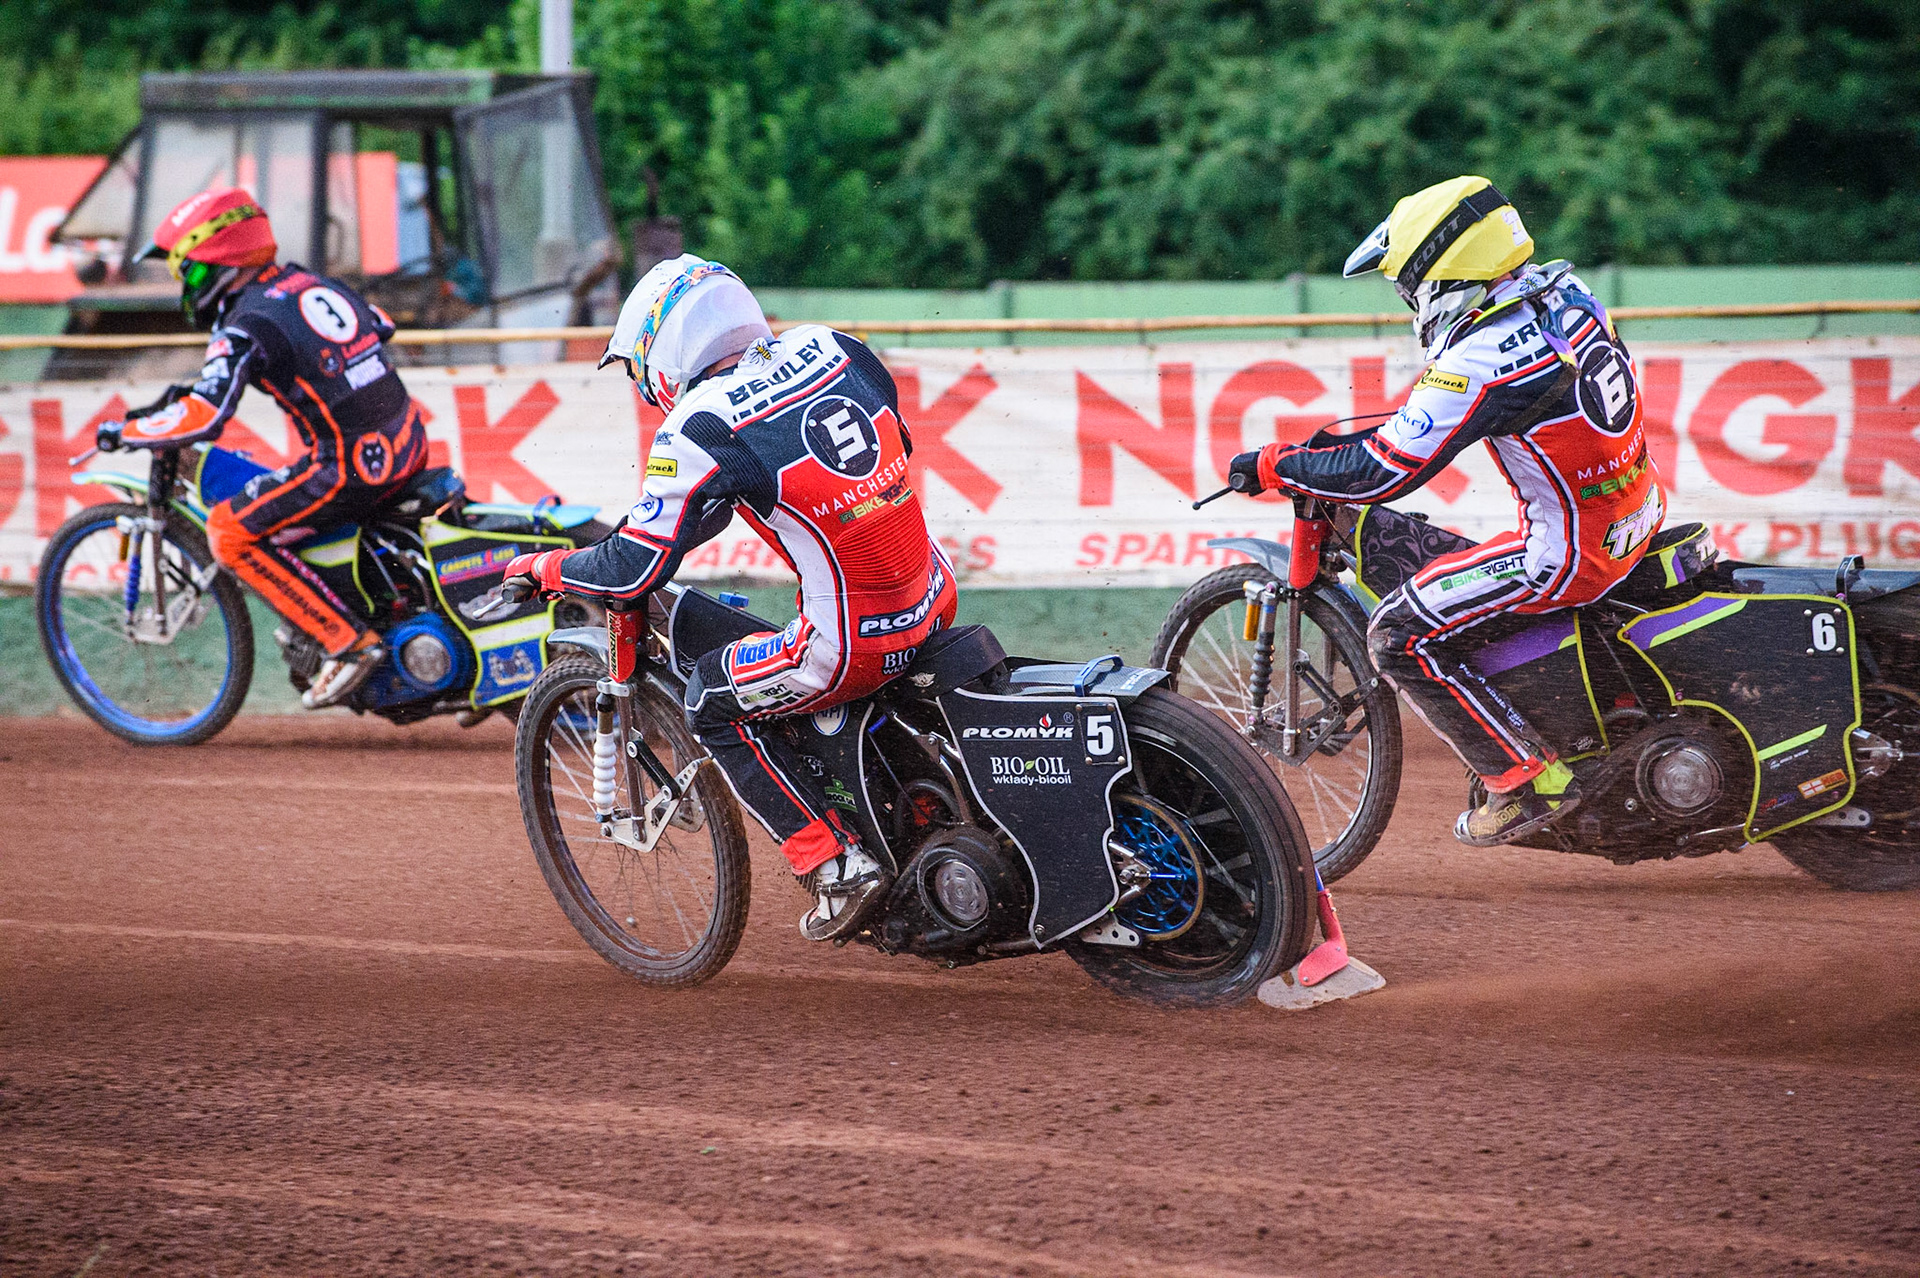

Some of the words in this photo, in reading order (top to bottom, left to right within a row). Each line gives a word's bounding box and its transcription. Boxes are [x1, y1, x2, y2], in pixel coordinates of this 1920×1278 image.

[1403, 214, 1461, 287] SCOTT
[315, 295, 346, 328] 3
[725, 338, 824, 406] BEWLEY
[1593, 358, 1630, 421] 6
[821, 407, 869, 462] 5
[1453, 556, 1526, 587] BIKERIGHT
[1811, 612, 1837, 652] 6
[884, 647, 917, 668] BIO
[962, 726, 1075, 739] PŁOMYK
[1086, 714, 1115, 756] 5
[990, 756, 1025, 775] BIO
[1034, 756, 1070, 775] OIL
[993, 774, 1072, 786] wkłady-biooil
